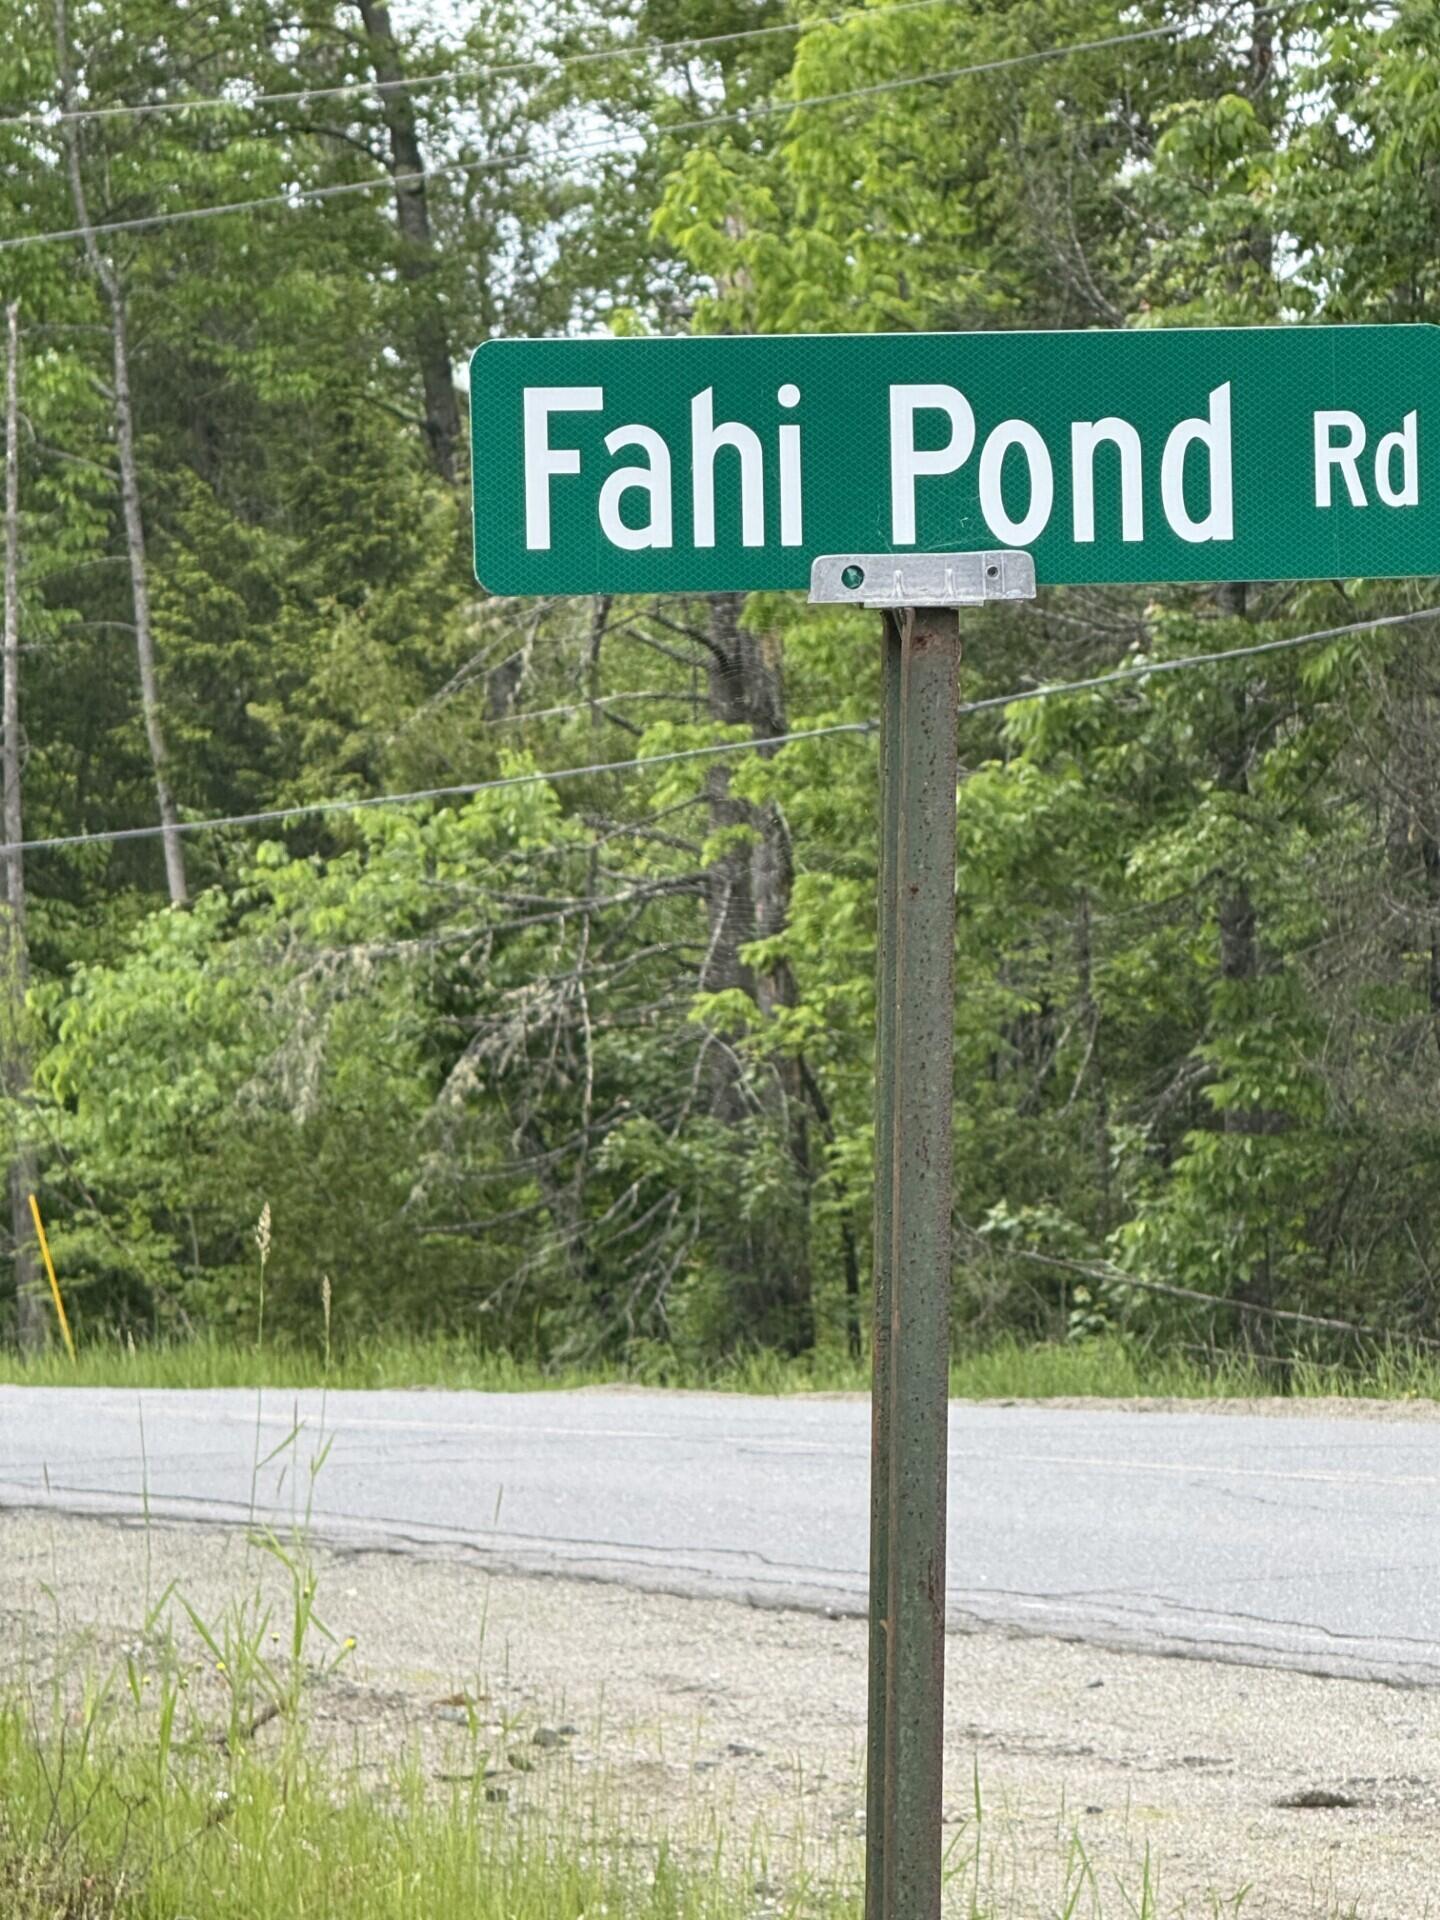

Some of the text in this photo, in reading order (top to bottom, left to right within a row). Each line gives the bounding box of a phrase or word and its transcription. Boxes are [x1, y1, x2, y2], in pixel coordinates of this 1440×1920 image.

[523, 381, 1419, 551] Fahi Pond Rd
